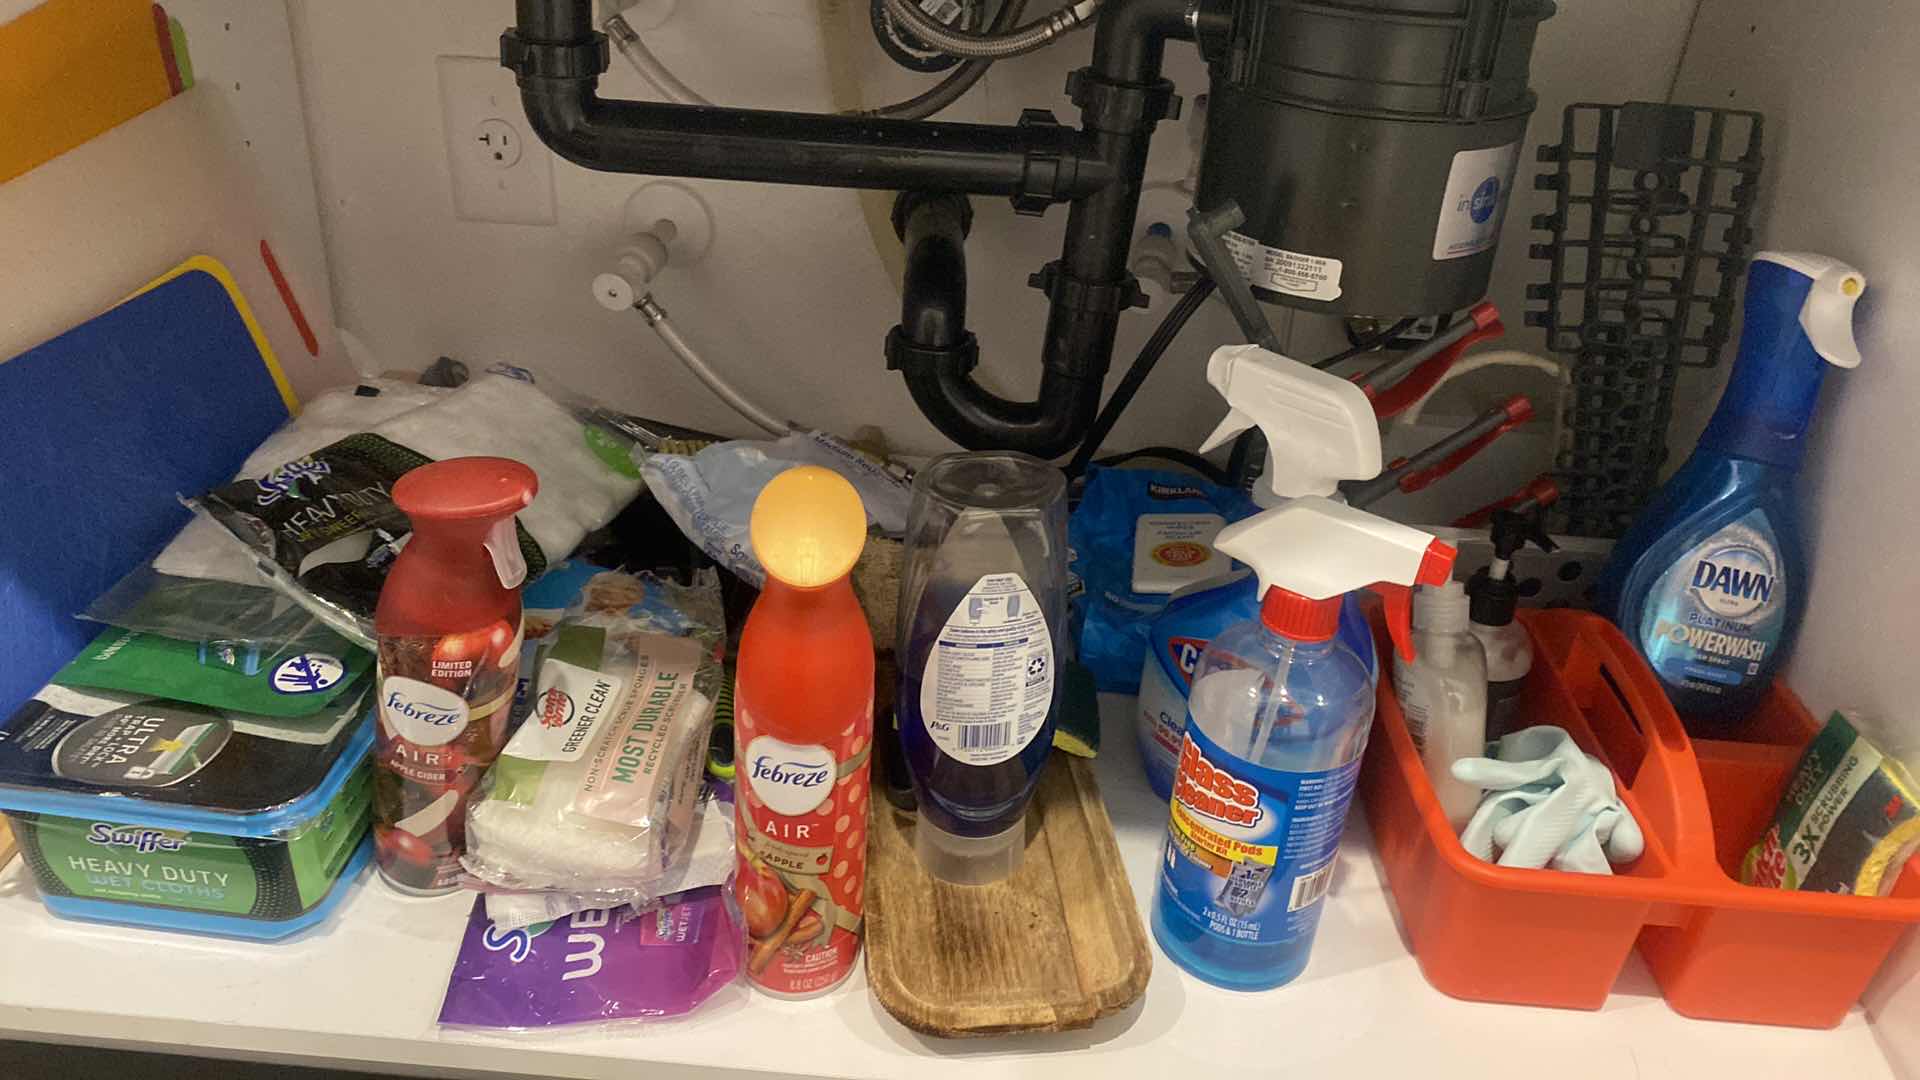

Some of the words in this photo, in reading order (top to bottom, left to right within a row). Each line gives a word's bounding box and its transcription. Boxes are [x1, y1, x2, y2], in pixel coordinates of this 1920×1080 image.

[1692, 559, 1775, 603] DAWN
[1656, 617, 1767, 662] POWERWASH
[431, 660, 473, 669] LIMITED
[431, 669, 473, 678] EDITION
[386, 691, 460, 727] febreze
[562, 713, 595, 753] GREENER
[585, 681, 612, 715] CLEAN
[106, 717, 165, 765] ULTRA
[611, 735, 648, 784] MOST
[632, 671, 679, 734] DURABLE
[930, 721, 950, 732] P&G
[395, 743, 440, 765] AIR
[643, 725, 669, 775] RECYCLED
[752, 755, 828, 788] febreze
[1792, 823, 1821, 865] 3X
[1811, 755, 1859, 824] SCRUBBING
[1818, 788, 1849, 832] POWER
[87, 823, 186, 854] Swiffer
[765, 820, 810, 839] AIR
[765, 853, 805, 870] APPLE
[1233, 841, 1264, 856] Pods
[68, 855, 151, 878] HEAVY
[161, 866, 229, 887] DUTY
